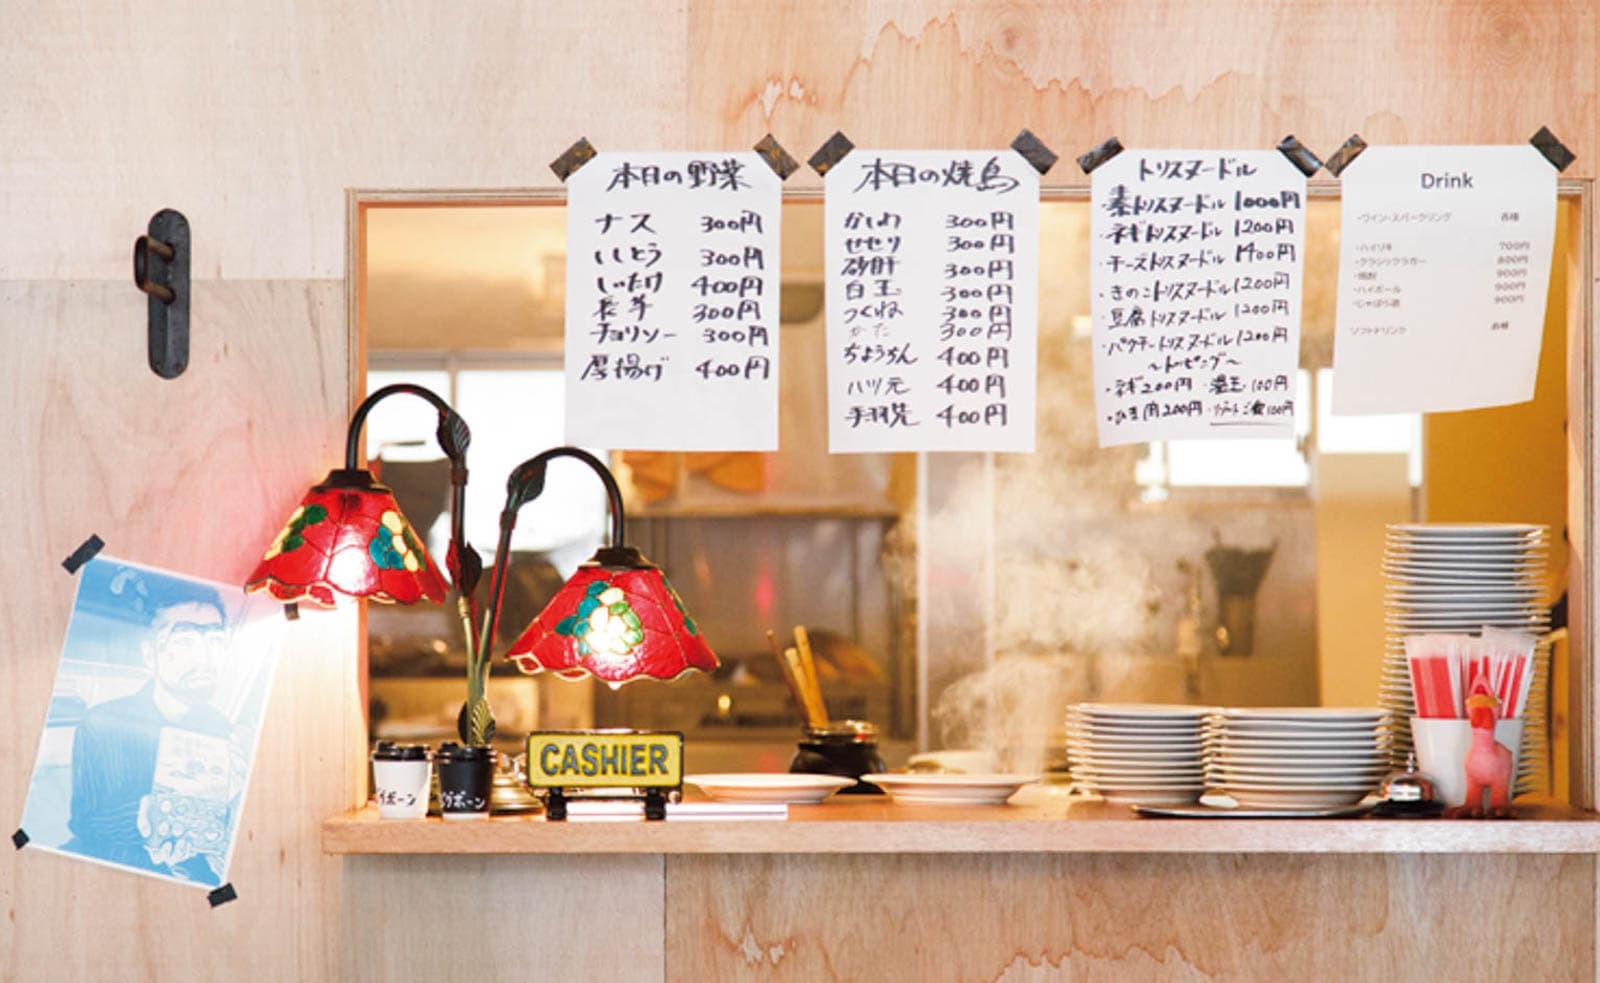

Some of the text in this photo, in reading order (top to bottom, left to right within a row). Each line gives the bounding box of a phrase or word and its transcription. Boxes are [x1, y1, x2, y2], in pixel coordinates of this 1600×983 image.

[604, 157, 754, 194] 本日の野菜
[1138, 156, 1258, 182] トリスヌードル
[1420, 172, 1474, 190] Drink
[1234, 189, 1302, 212] 1000円
[593, 208, 765, 236] ナス 300円
[944, 210, 1015, 232] 300円
[1234, 217, 1296, 238] 1200円
[844, 232, 1016, 254] せせり 300円
[1235, 241, 1297, 264] 1400円
[698, 244, 766, 272] 300円
[840, 255, 1015, 280] 砂肝 300円
[690, 274, 764, 297] 400円
[939, 282, 1014, 305] 300円
[1234, 271, 1291, 294] 1200円
[692, 298, 762, 323] 300円
[843, 300, 1012, 325] つくね 300円
[1234, 299, 1290, 318] 1200円
[589, 322, 770, 347] チョリソー 300円
[938, 322, 1013, 343] 300円
[1236, 325, 1289, 347] 1200円
[580, 353, 771, 382] 厚揚げ 400円
[935, 345, 1009, 369] 400円
[847, 373, 1007, 399] ハツ元 400円
[843, 401, 1009, 429] 手羽先 400円
[540, 743, 670, 777] CASHIER
